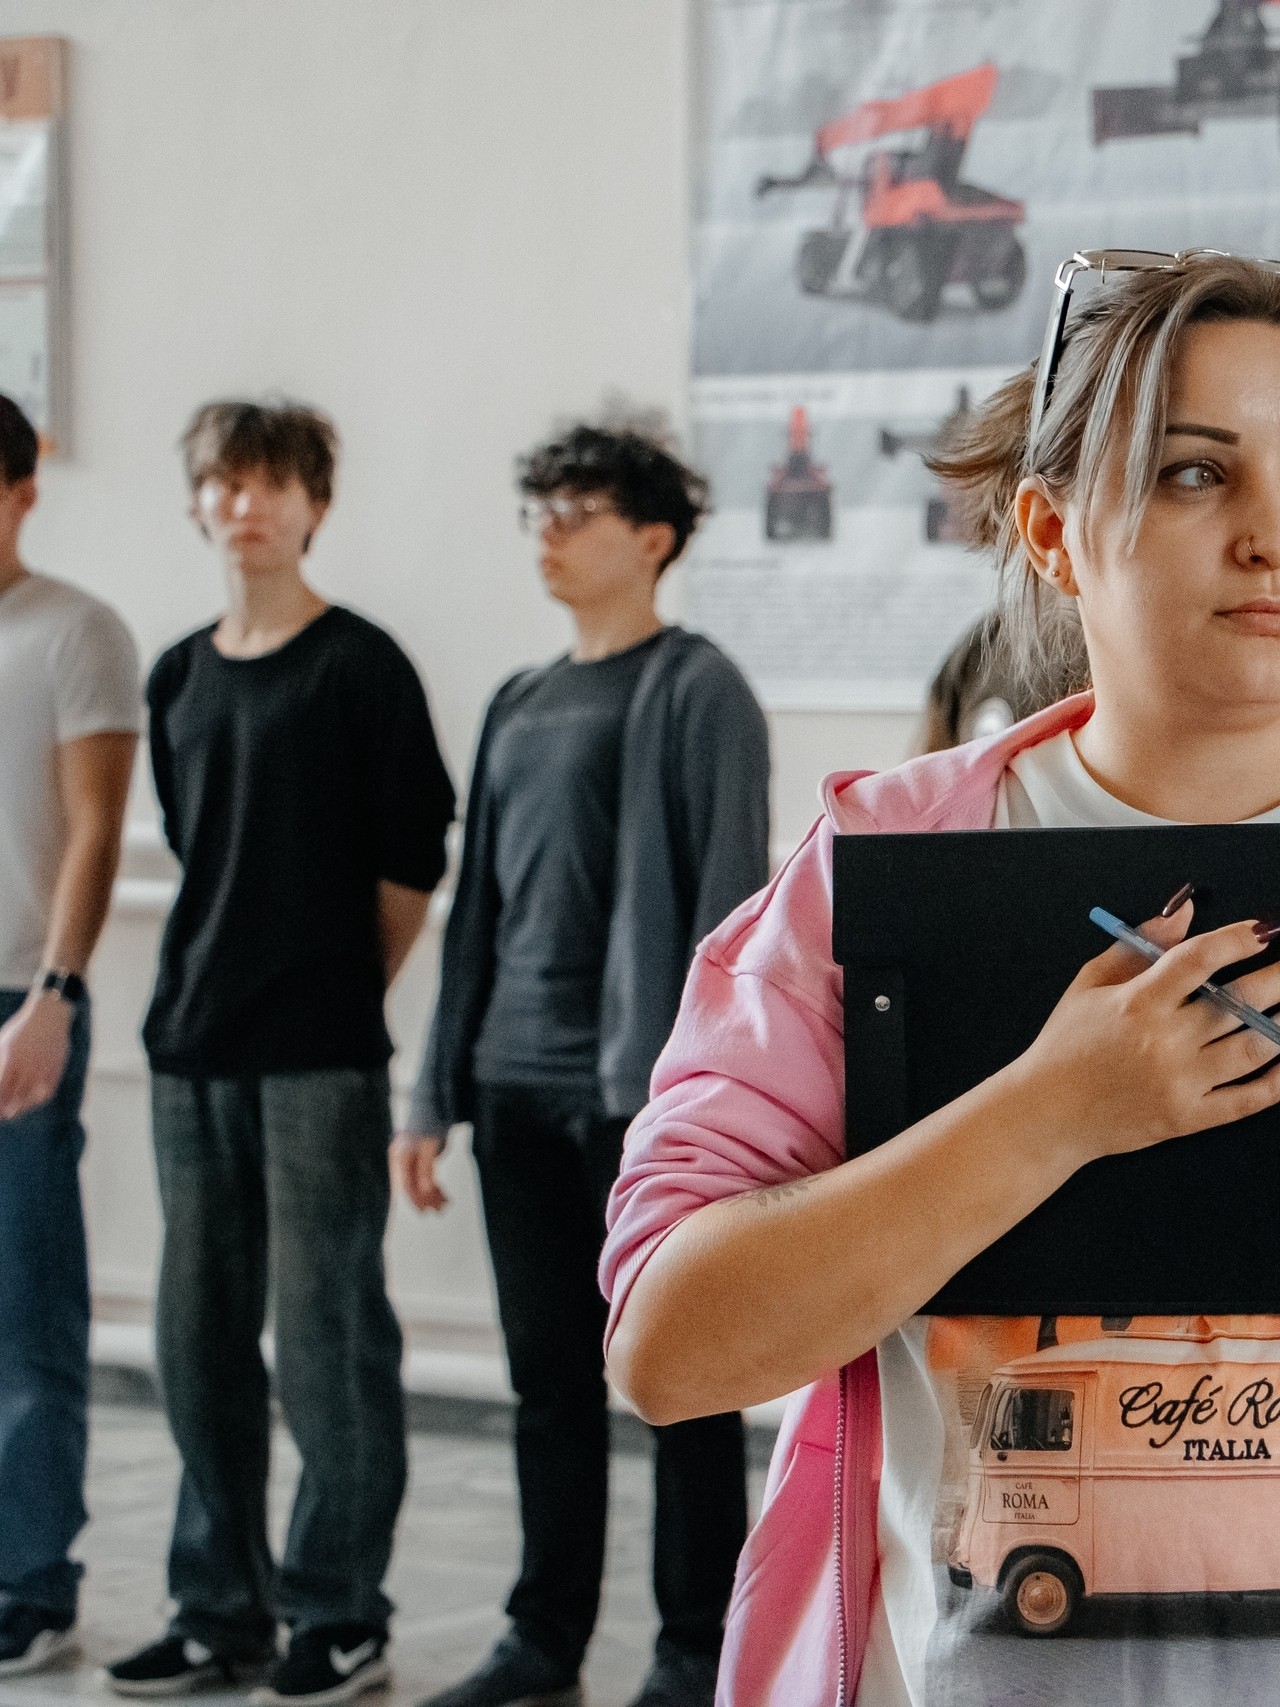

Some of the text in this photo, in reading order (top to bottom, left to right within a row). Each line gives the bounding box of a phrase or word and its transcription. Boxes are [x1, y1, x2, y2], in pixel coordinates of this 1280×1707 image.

[1119, 1375, 1224, 1448] Café
[1183, 1438, 1271, 1461] ITALIA
[1002, 1493, 1049, 1510] ROMA
[1014, 1512, 1035, 1520] ITALIA
